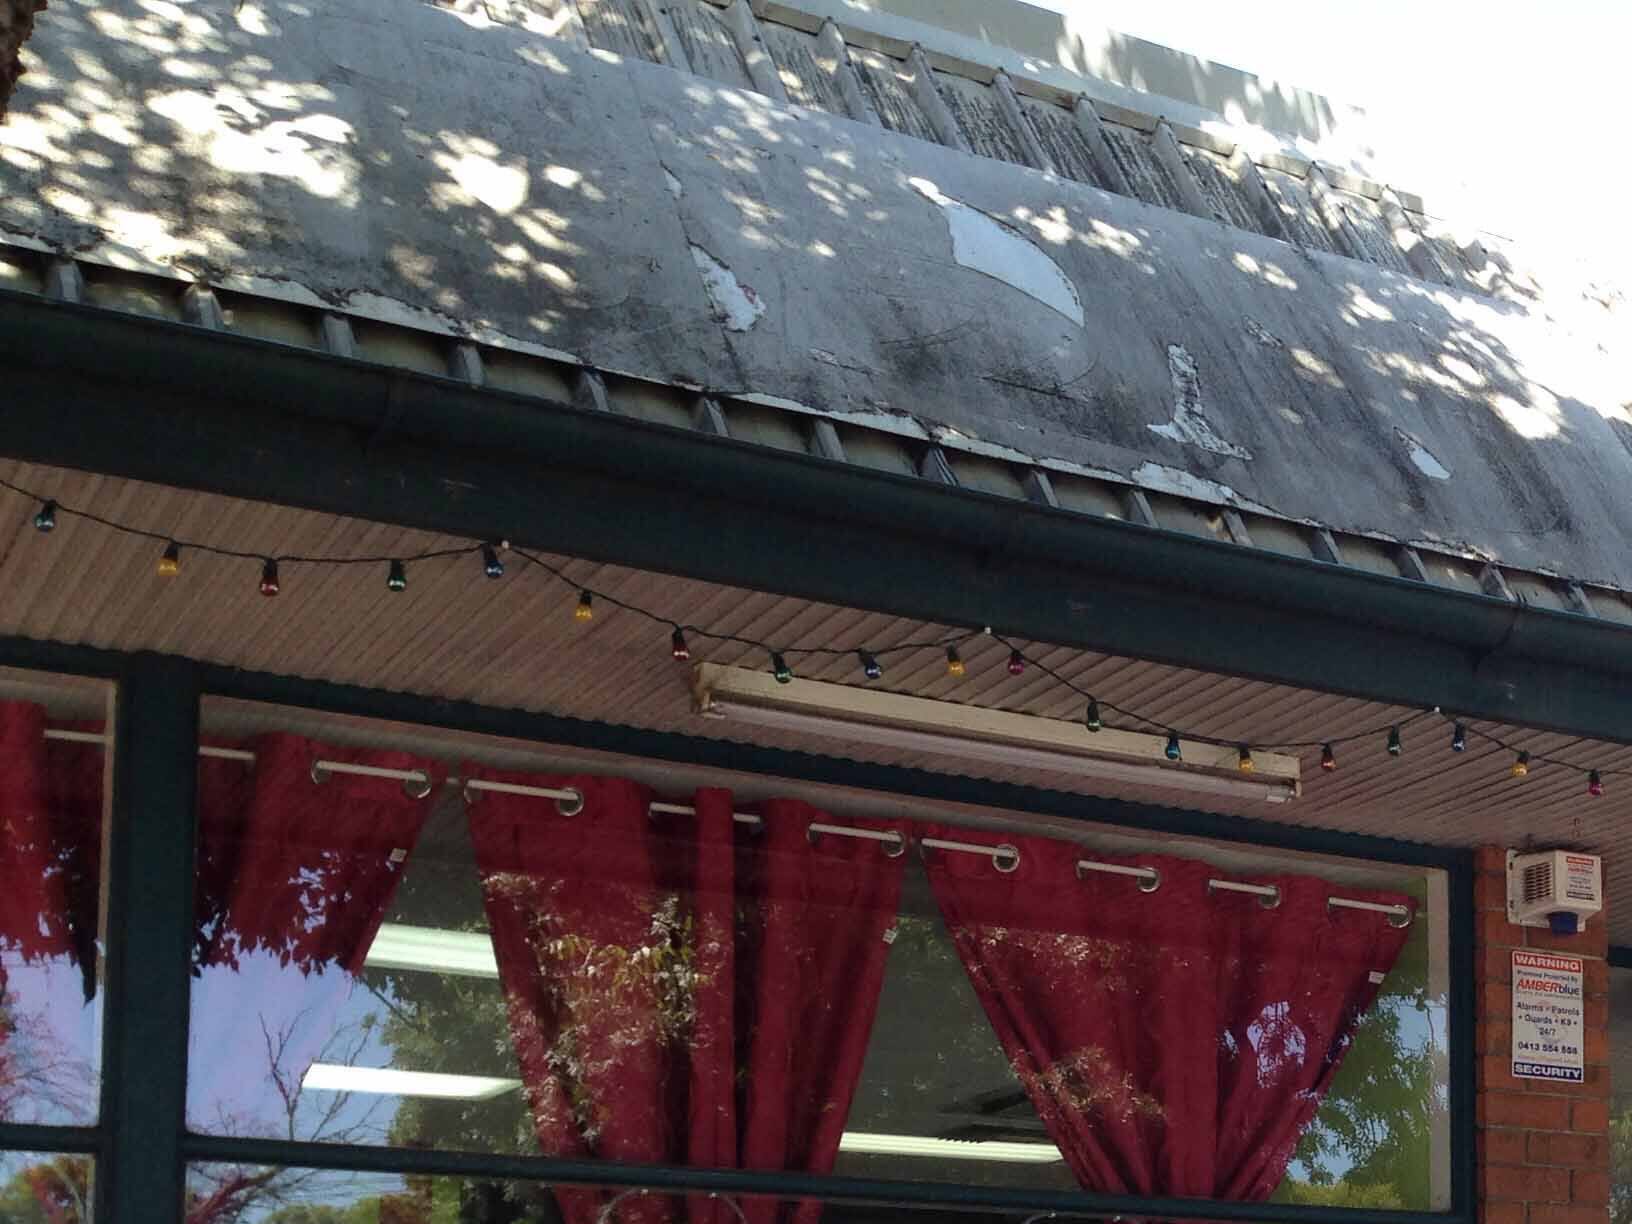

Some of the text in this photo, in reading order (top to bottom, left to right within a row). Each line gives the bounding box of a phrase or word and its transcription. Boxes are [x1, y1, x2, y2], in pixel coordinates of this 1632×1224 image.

[1515, 954, 1579, 970] WARNING
[1516, 1001, 1579, 1016] Alarms Patrols
[1524, 1013, 1552, 1024] Guards
[1539, 1026, 1556, 1036] 24/7
[1518, 1040, 1540, 1052] 0413
[1515, 1063, 1581, 1079] SECURITY
